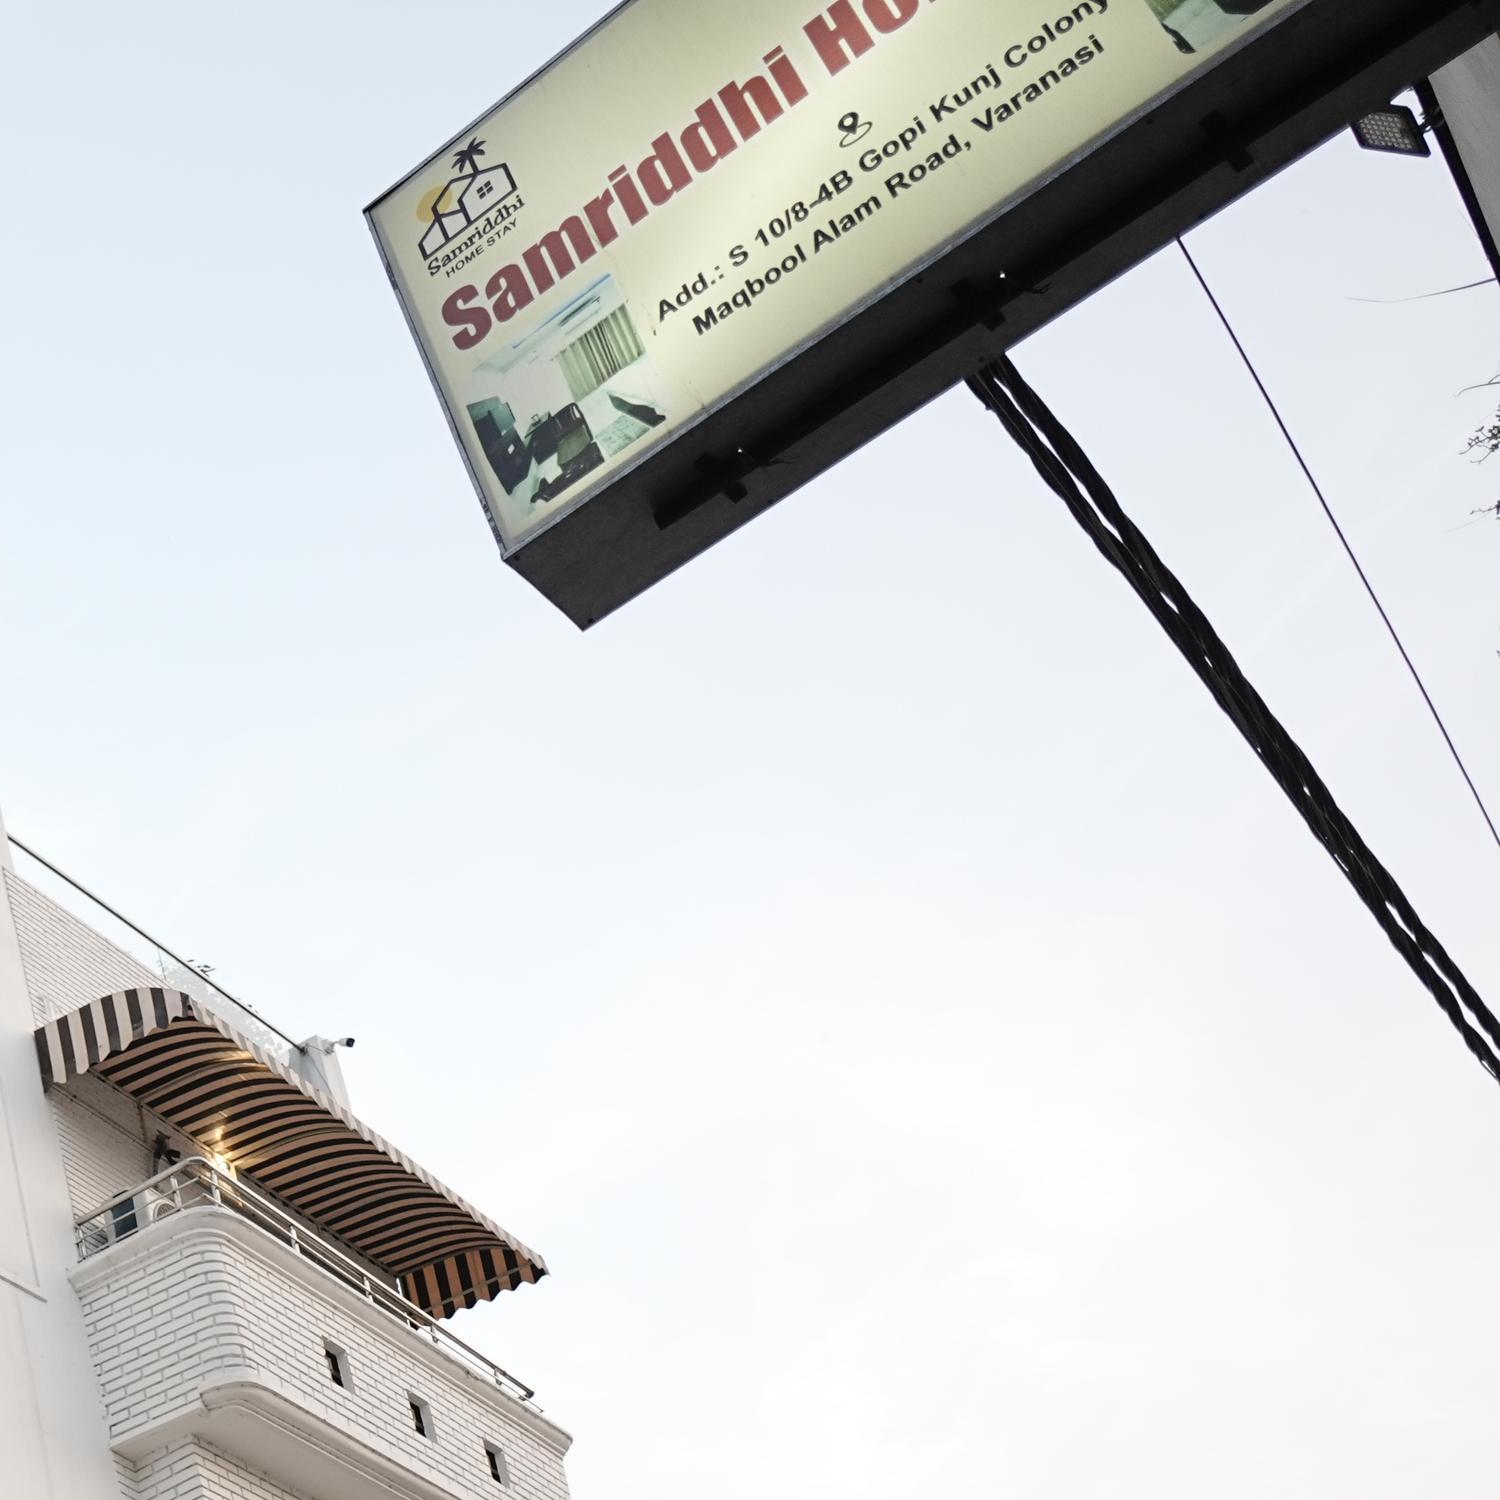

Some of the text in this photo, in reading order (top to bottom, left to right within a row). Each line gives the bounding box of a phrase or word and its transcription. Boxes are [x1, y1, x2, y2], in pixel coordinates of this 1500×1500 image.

[427, 195, 525, 277] Samriddhi
[441, 0, 936, 351] Samriddhi Ho
[445, 218, 518, 278] HOME STAY
[657, 264, 725, 323] Add.:
[728, 245, 750, 268] S
[754, 170, 854, 246] 10/8-4B
[858, 116, 927, 173] Gopi
[929, 63, 1002, 123] Kunj
[692, 34, 1105, 336] Maqbool Alam Road, Varanasi
